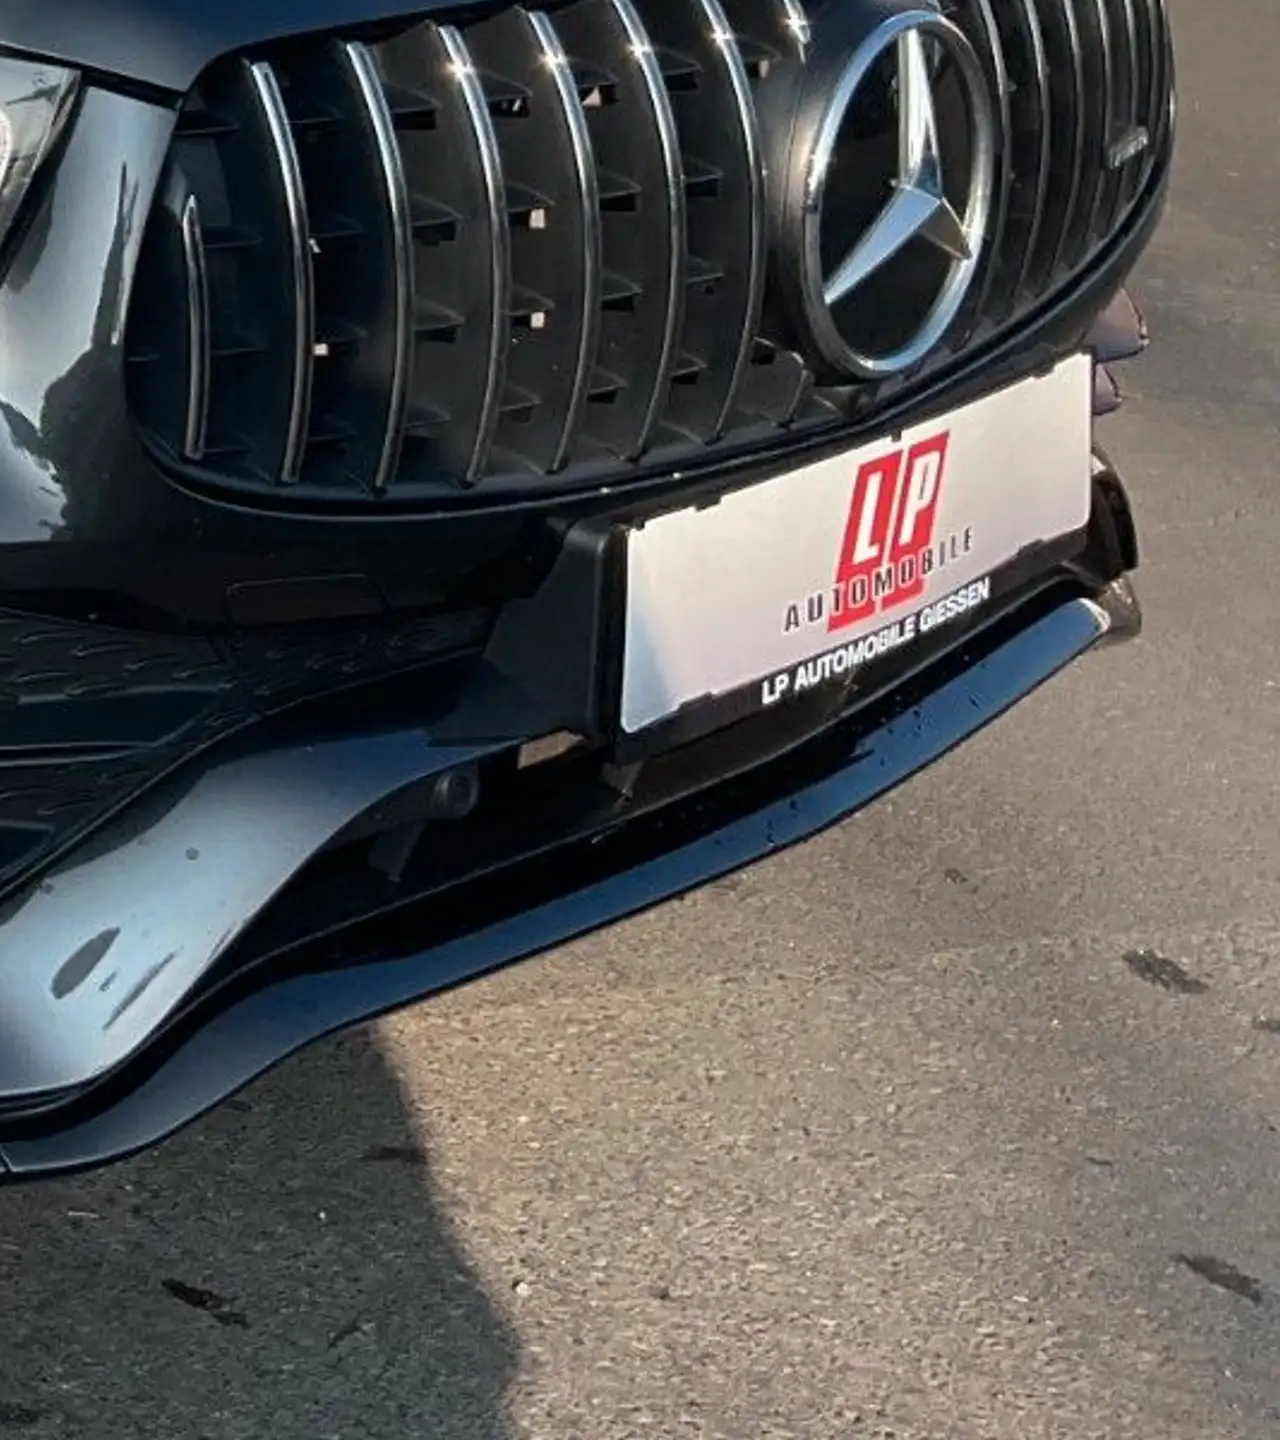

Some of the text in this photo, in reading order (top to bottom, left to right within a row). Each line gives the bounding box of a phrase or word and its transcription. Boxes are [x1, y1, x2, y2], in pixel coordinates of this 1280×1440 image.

[851, 449, 942, 565] LP
[783, 526, 973, 633] AUTOMOBILE
[761, 576, 991, 705] LP AUTOMOBILE GIESSEN
